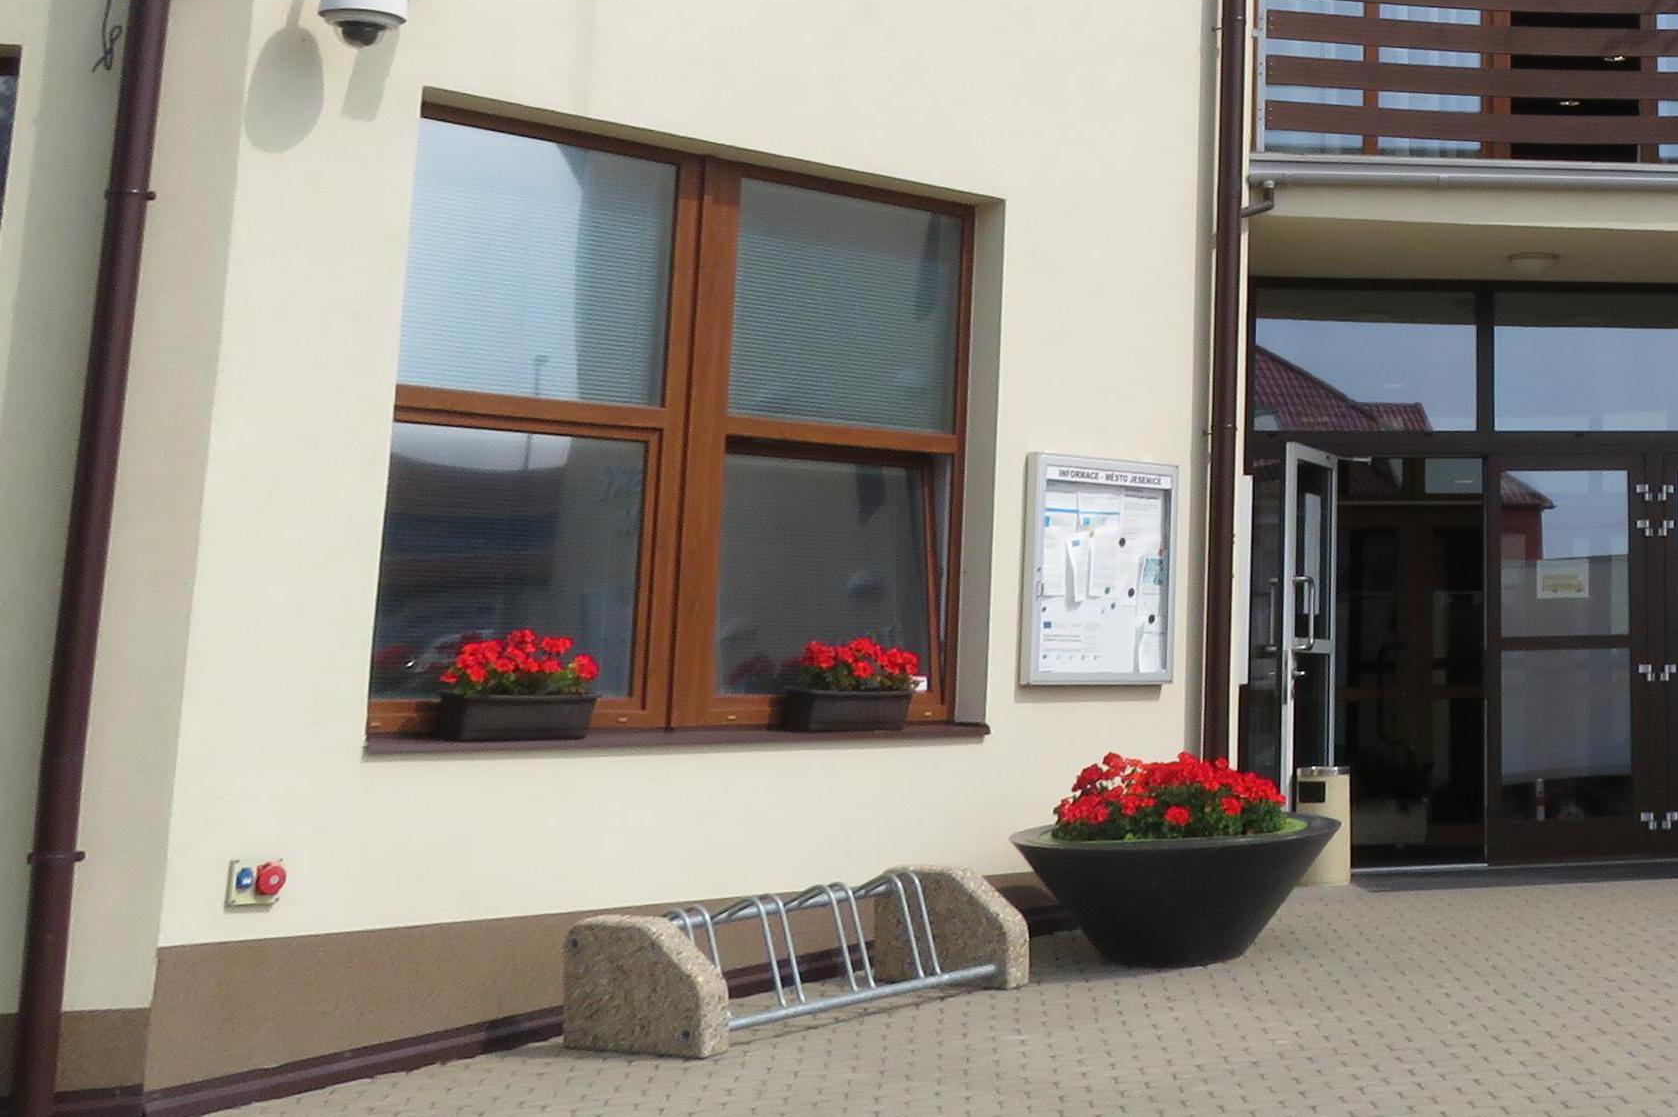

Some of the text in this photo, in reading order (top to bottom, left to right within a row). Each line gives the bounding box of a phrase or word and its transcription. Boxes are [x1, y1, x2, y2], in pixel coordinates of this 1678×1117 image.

[1058, 469, 1099, 481] INFORMACE
[1105, 472, 1128, 483] MĚSTO
[1130, 475, 1162, 486] JESENICE
